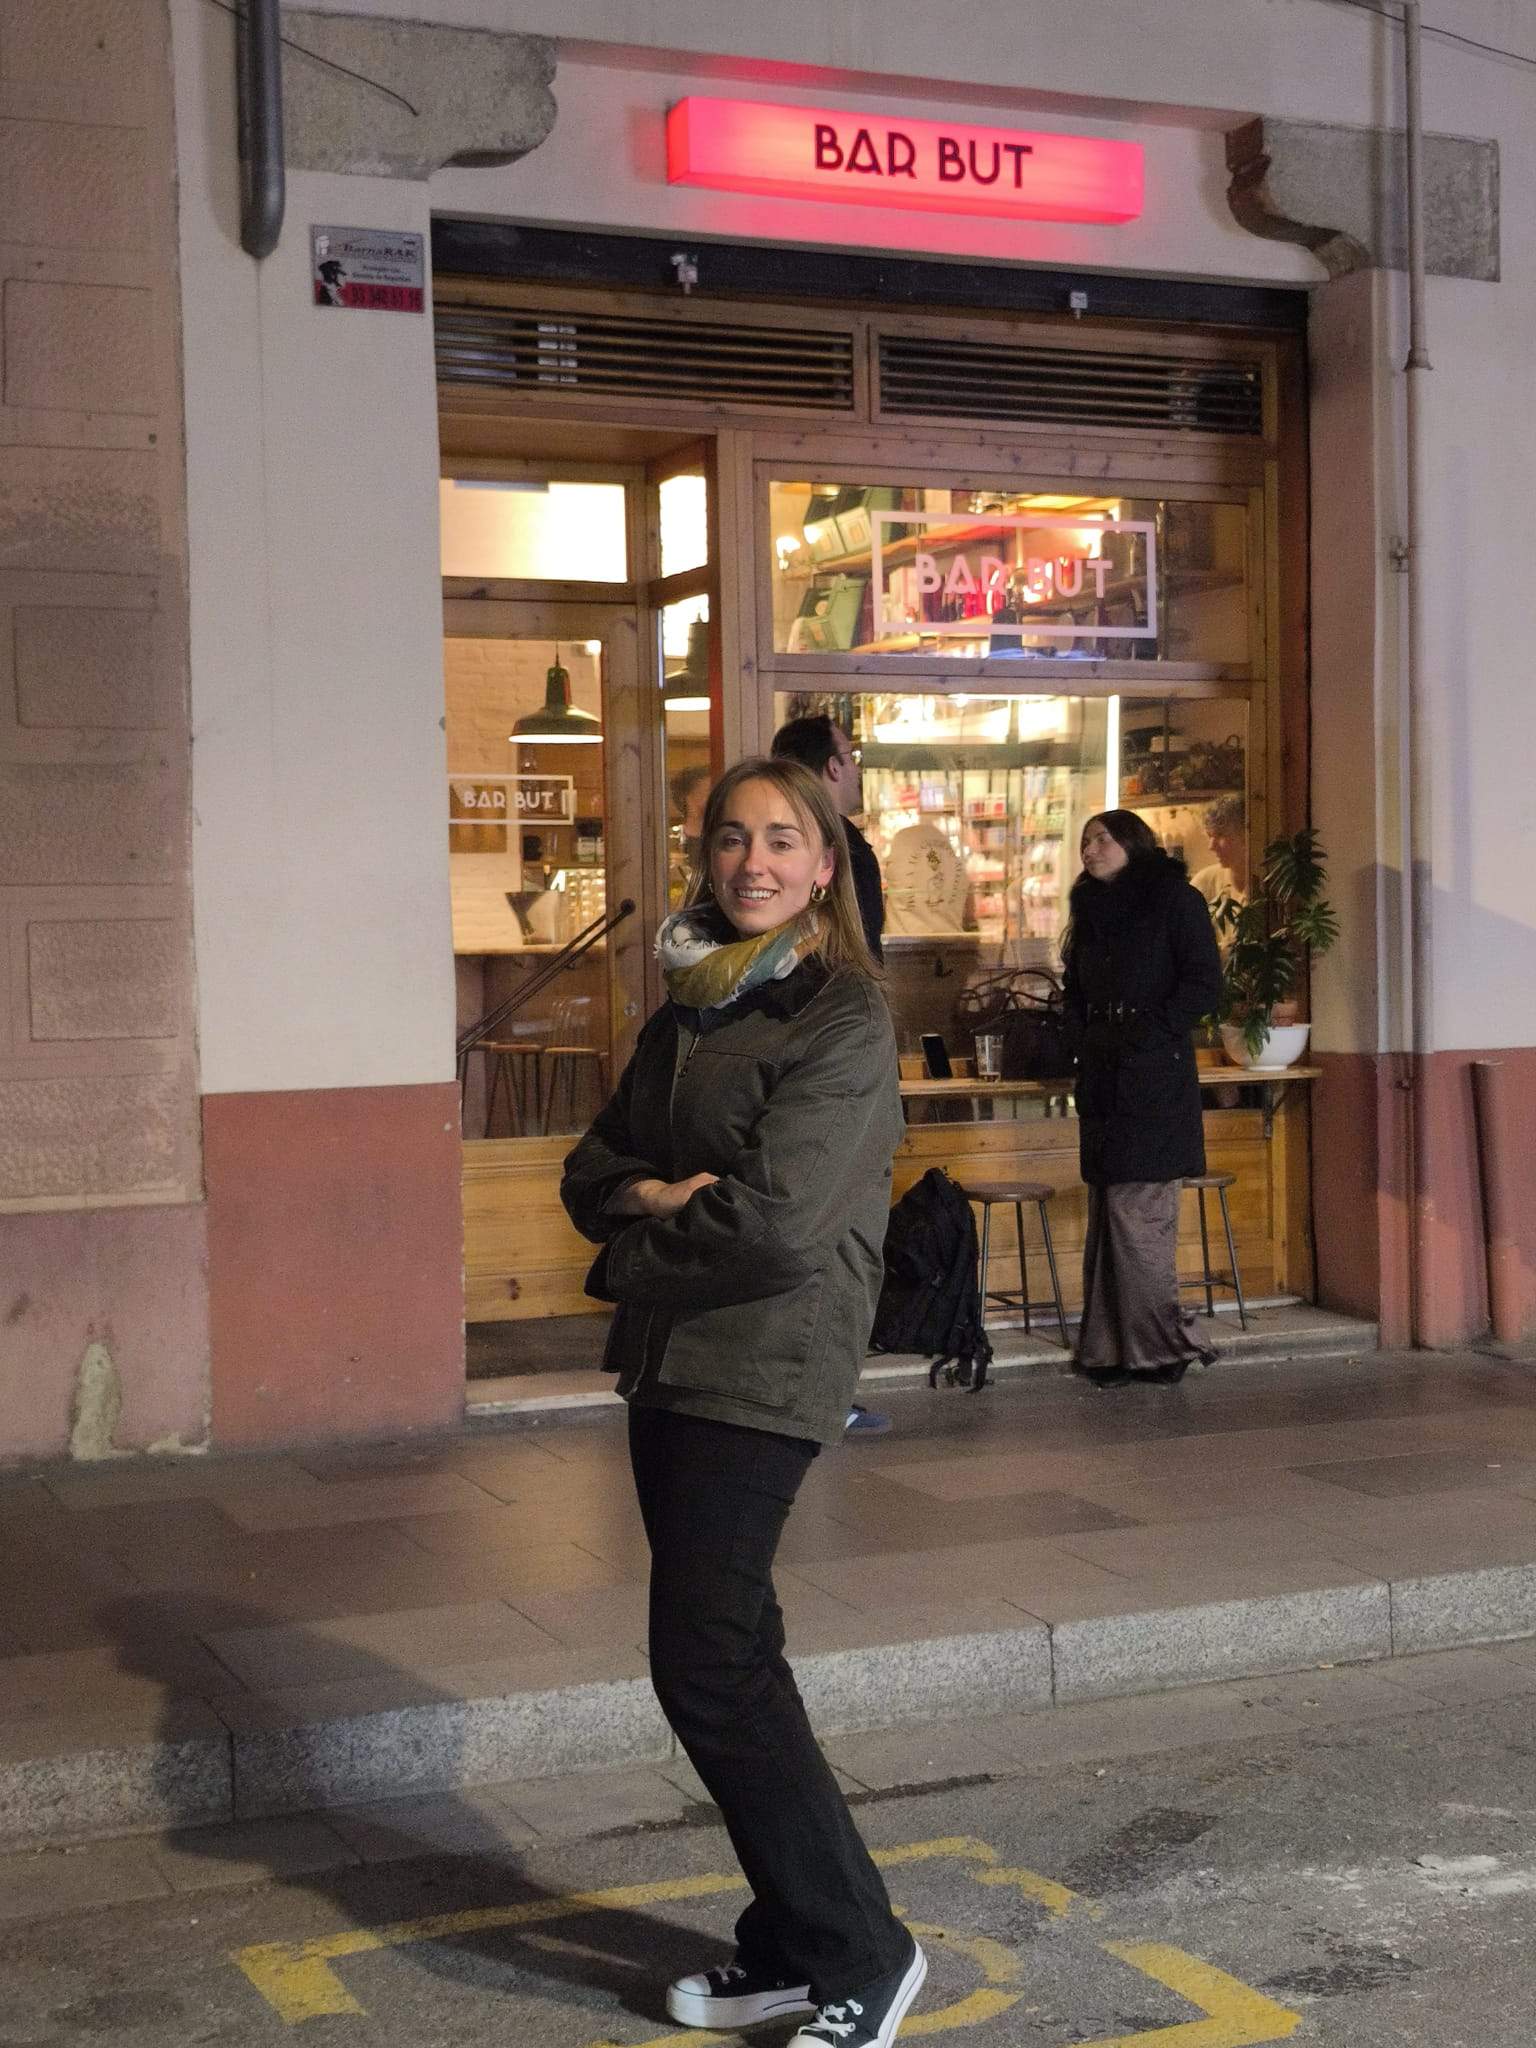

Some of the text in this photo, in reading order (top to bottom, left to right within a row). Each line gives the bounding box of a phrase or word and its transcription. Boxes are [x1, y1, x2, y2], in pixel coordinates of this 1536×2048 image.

[815, 124, 1032, 189] BAR BUT
[916, 554, 1113, 599] BAR BUT
[464, 790, 554, 809] BAR BUT
